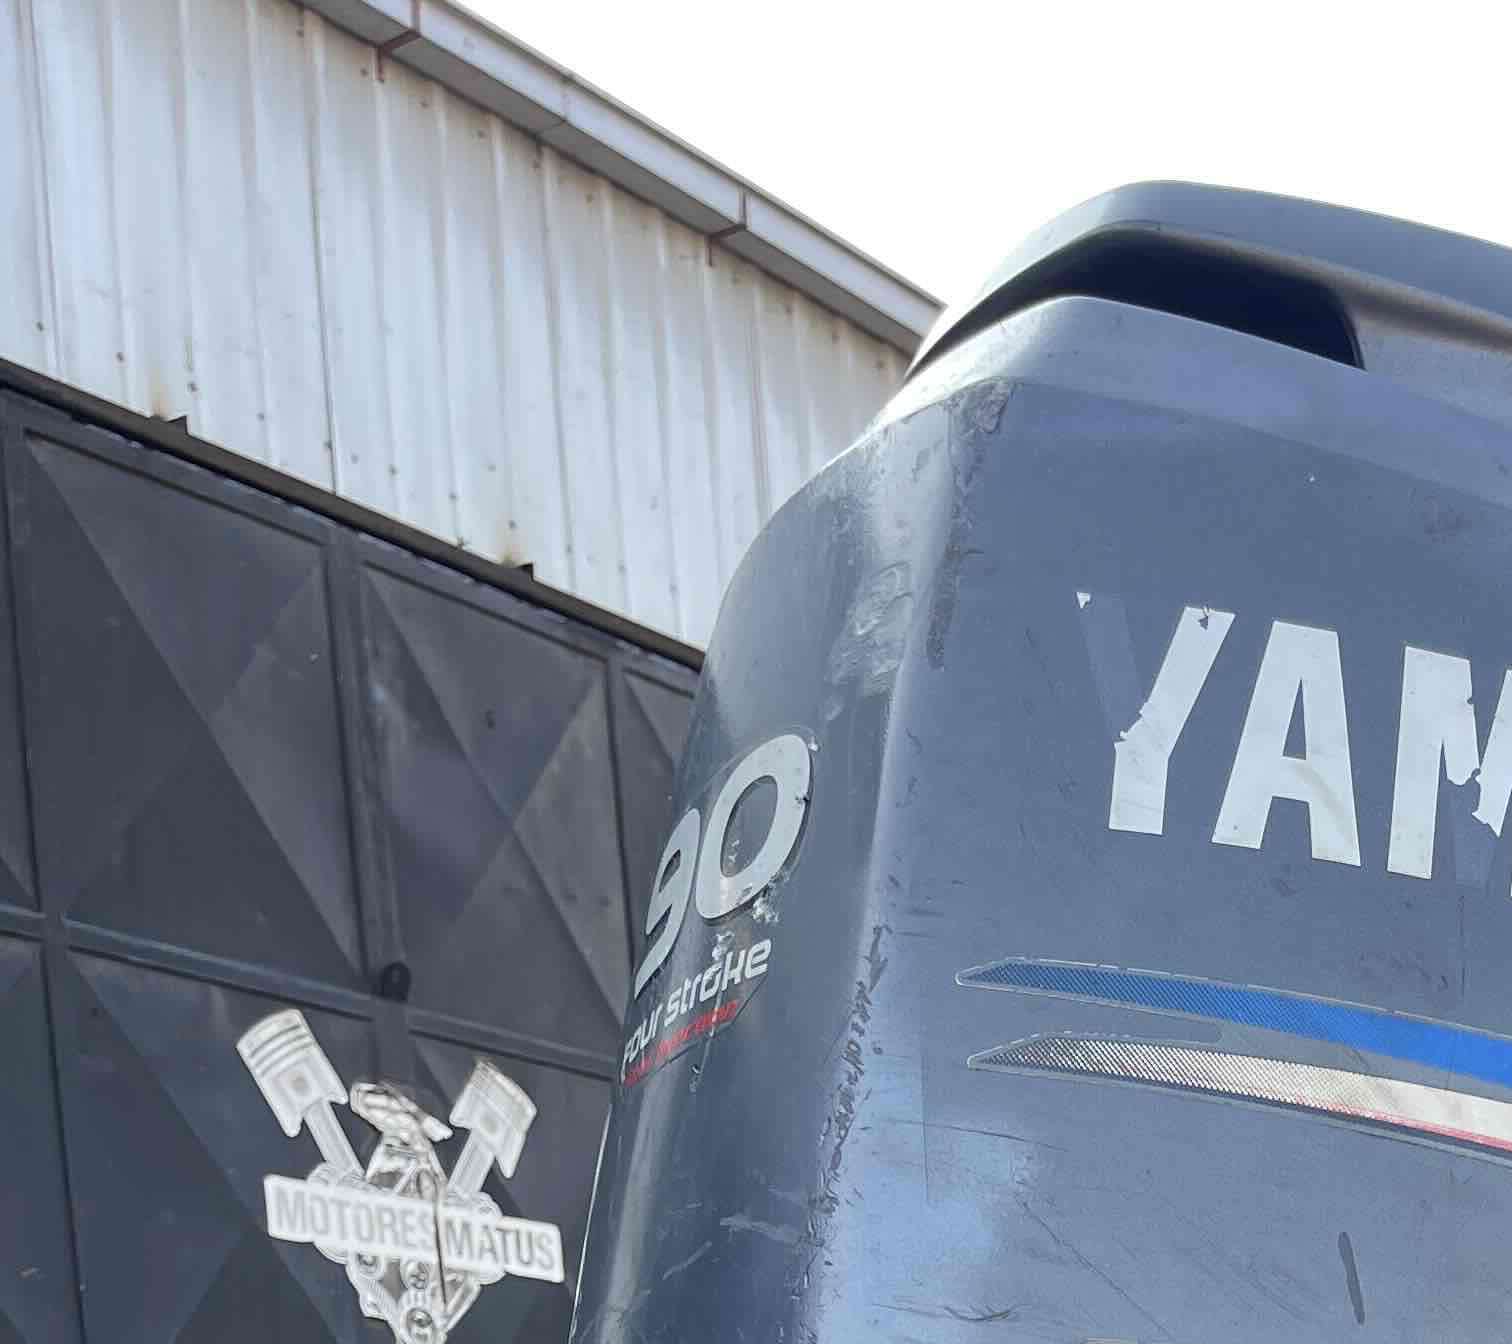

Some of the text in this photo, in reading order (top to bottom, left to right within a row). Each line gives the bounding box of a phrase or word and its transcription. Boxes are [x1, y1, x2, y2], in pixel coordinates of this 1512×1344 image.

[634, 734, 811, 1000] 90
[275, 1188, 554, 1271] MOTORES MATUS
